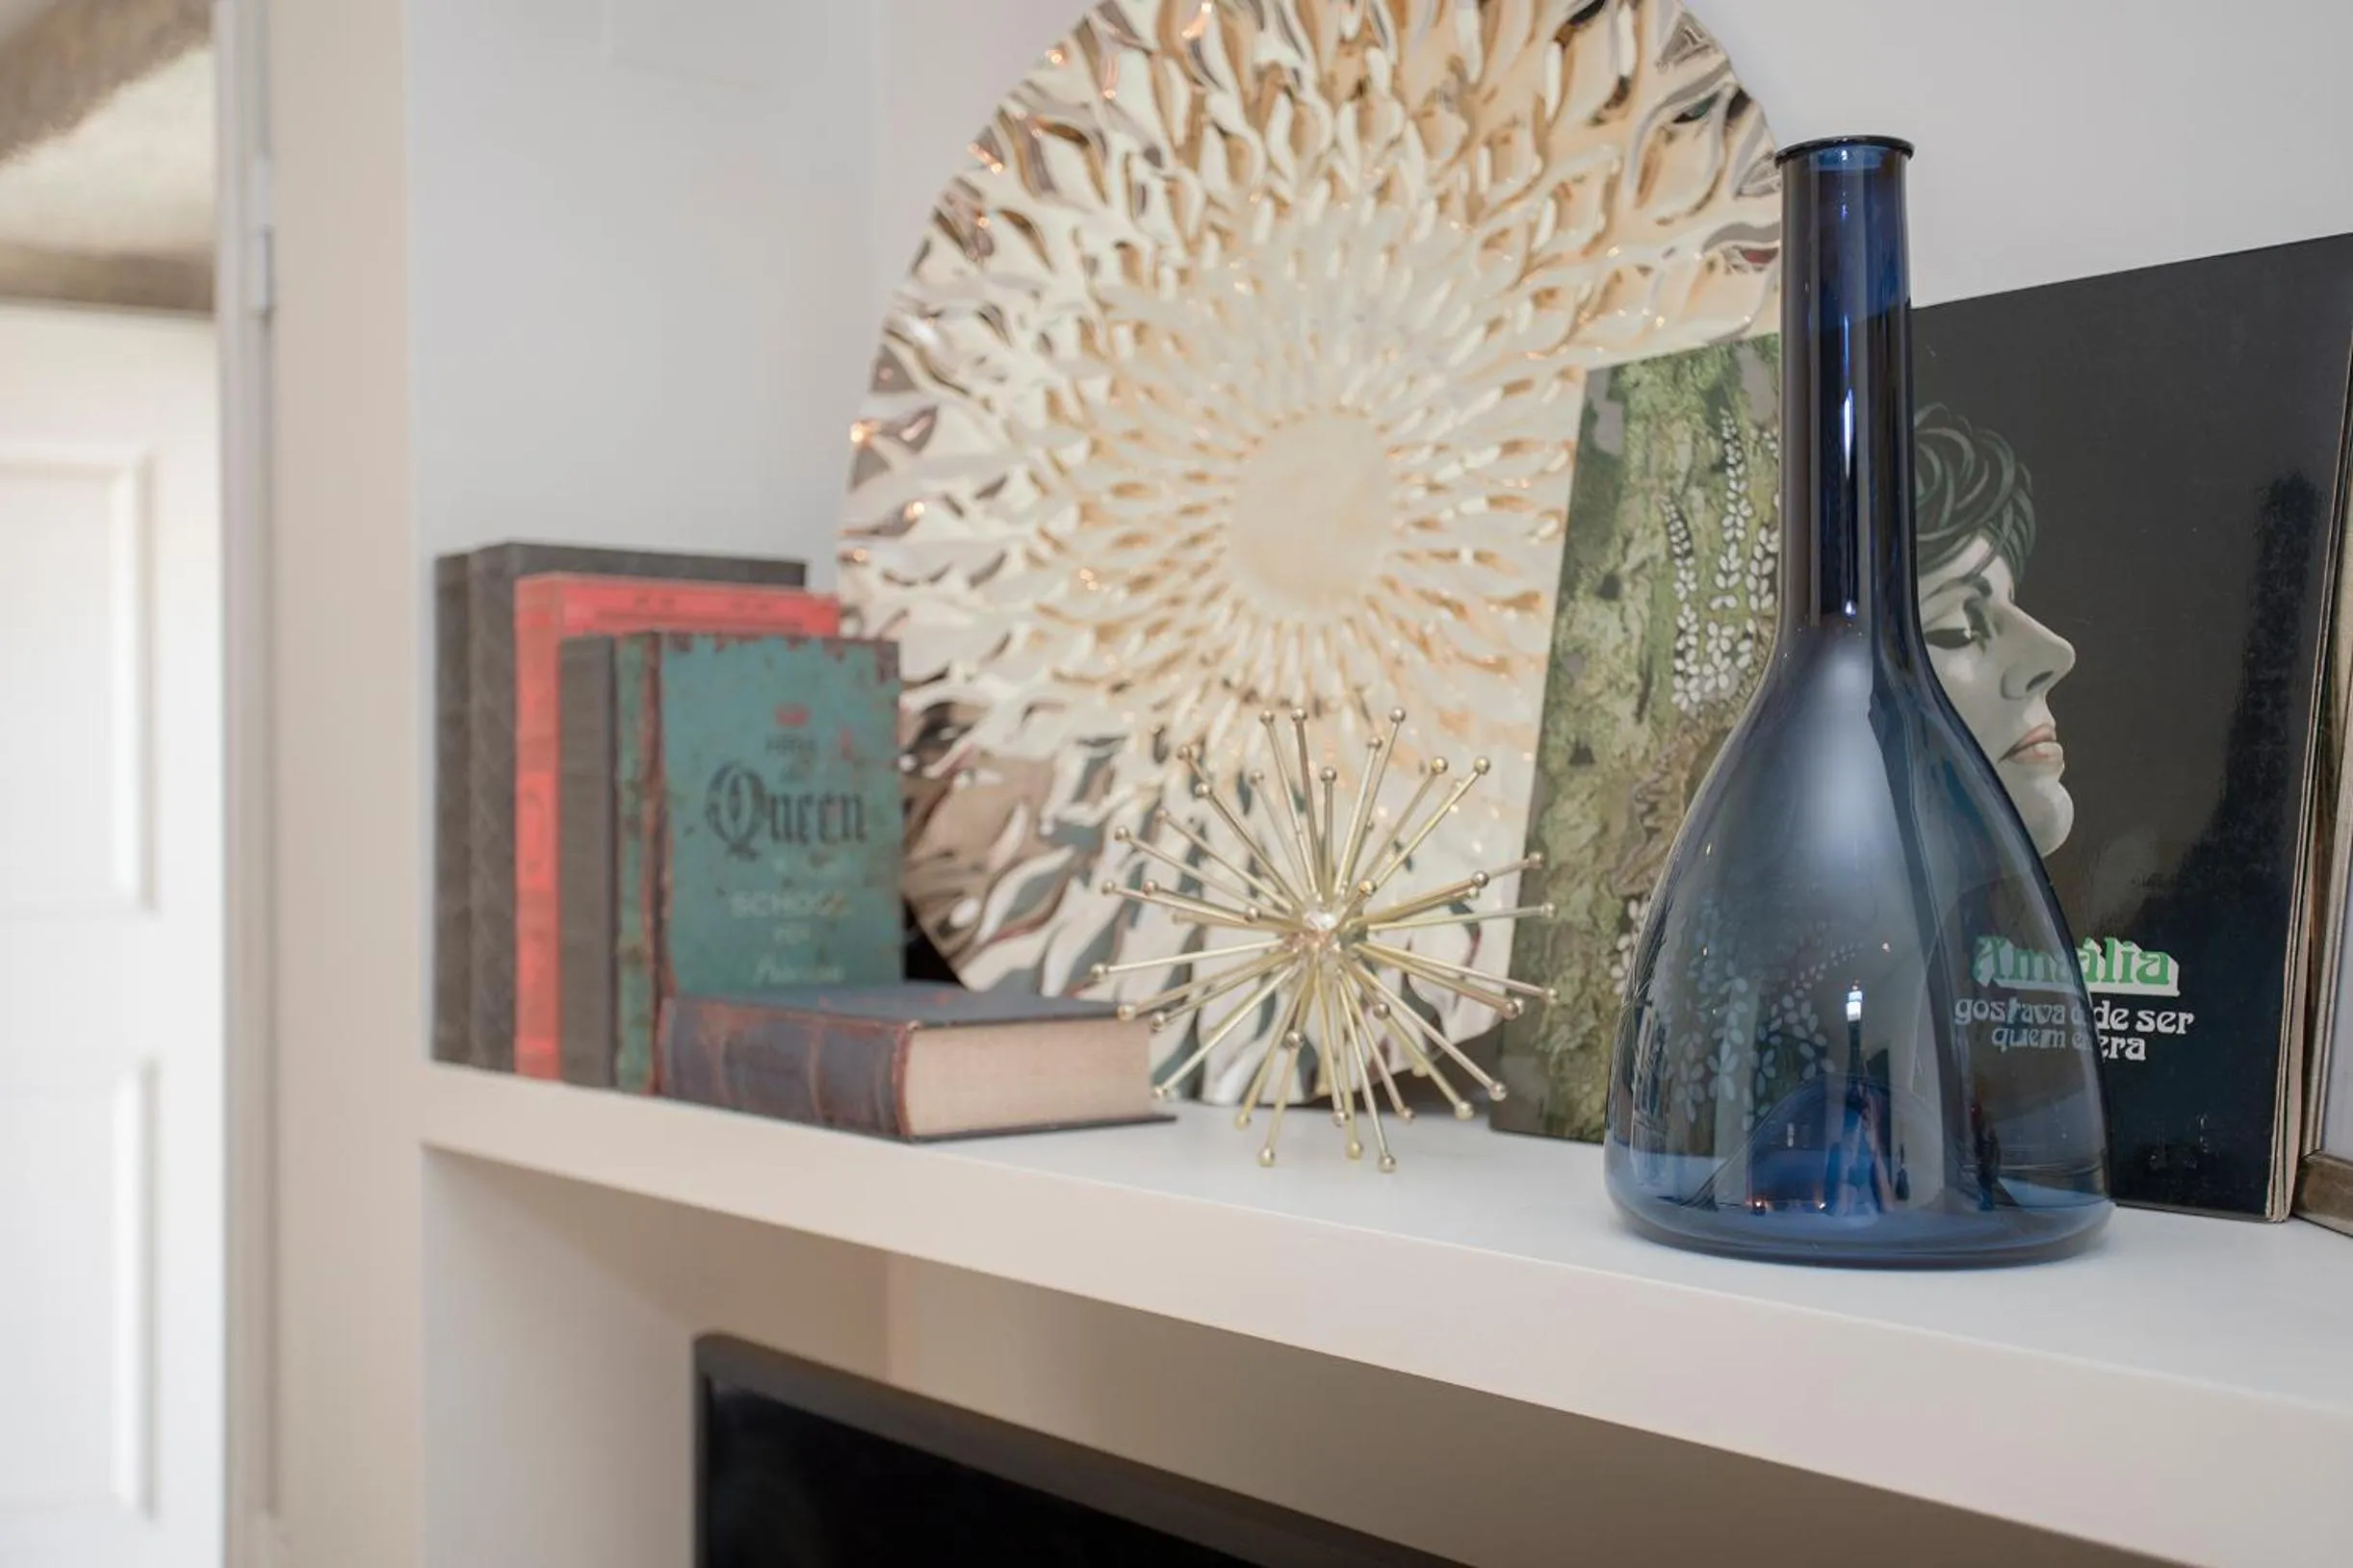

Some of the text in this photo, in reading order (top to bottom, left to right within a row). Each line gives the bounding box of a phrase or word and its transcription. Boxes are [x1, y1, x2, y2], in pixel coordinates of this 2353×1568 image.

[704, 759, 866, 861] Queen
[1954, 997, 2066, 1025] gostava
[2134, 1010, 2195, 1035] ser
[1991, 1026, 2066, 1053] quem
